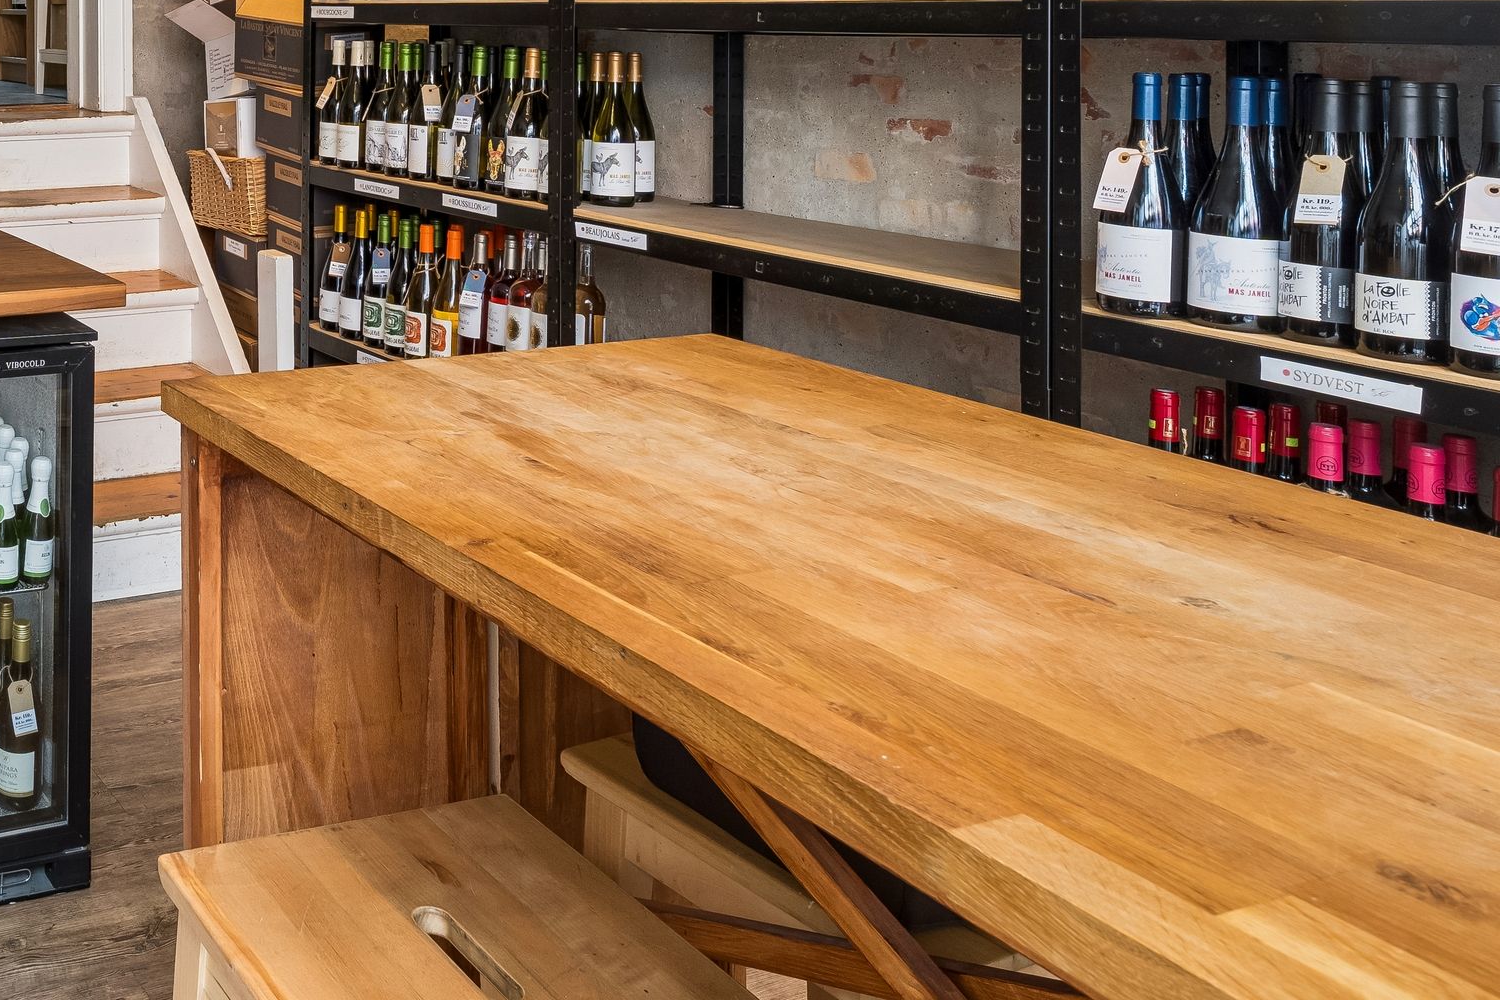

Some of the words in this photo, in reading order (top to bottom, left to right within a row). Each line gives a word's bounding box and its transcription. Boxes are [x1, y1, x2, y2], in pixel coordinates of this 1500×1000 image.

[585, 225, 620, 240] BEAUJOLAIS
[1470, 223, 1486, 231] Kr.
[1104, 272, 1116, 280] MAS
[1118, 274, 1142, 283] JANEIL
[1363, 280, 1374, 292] La
[1228, 288, 1245, 296] MAS
[1248, 290, 1271, 298] JANEIL
[6, 360, 46, 370] VIBOCOLD
[1293, 368, 1365, 394] SYDVEST
